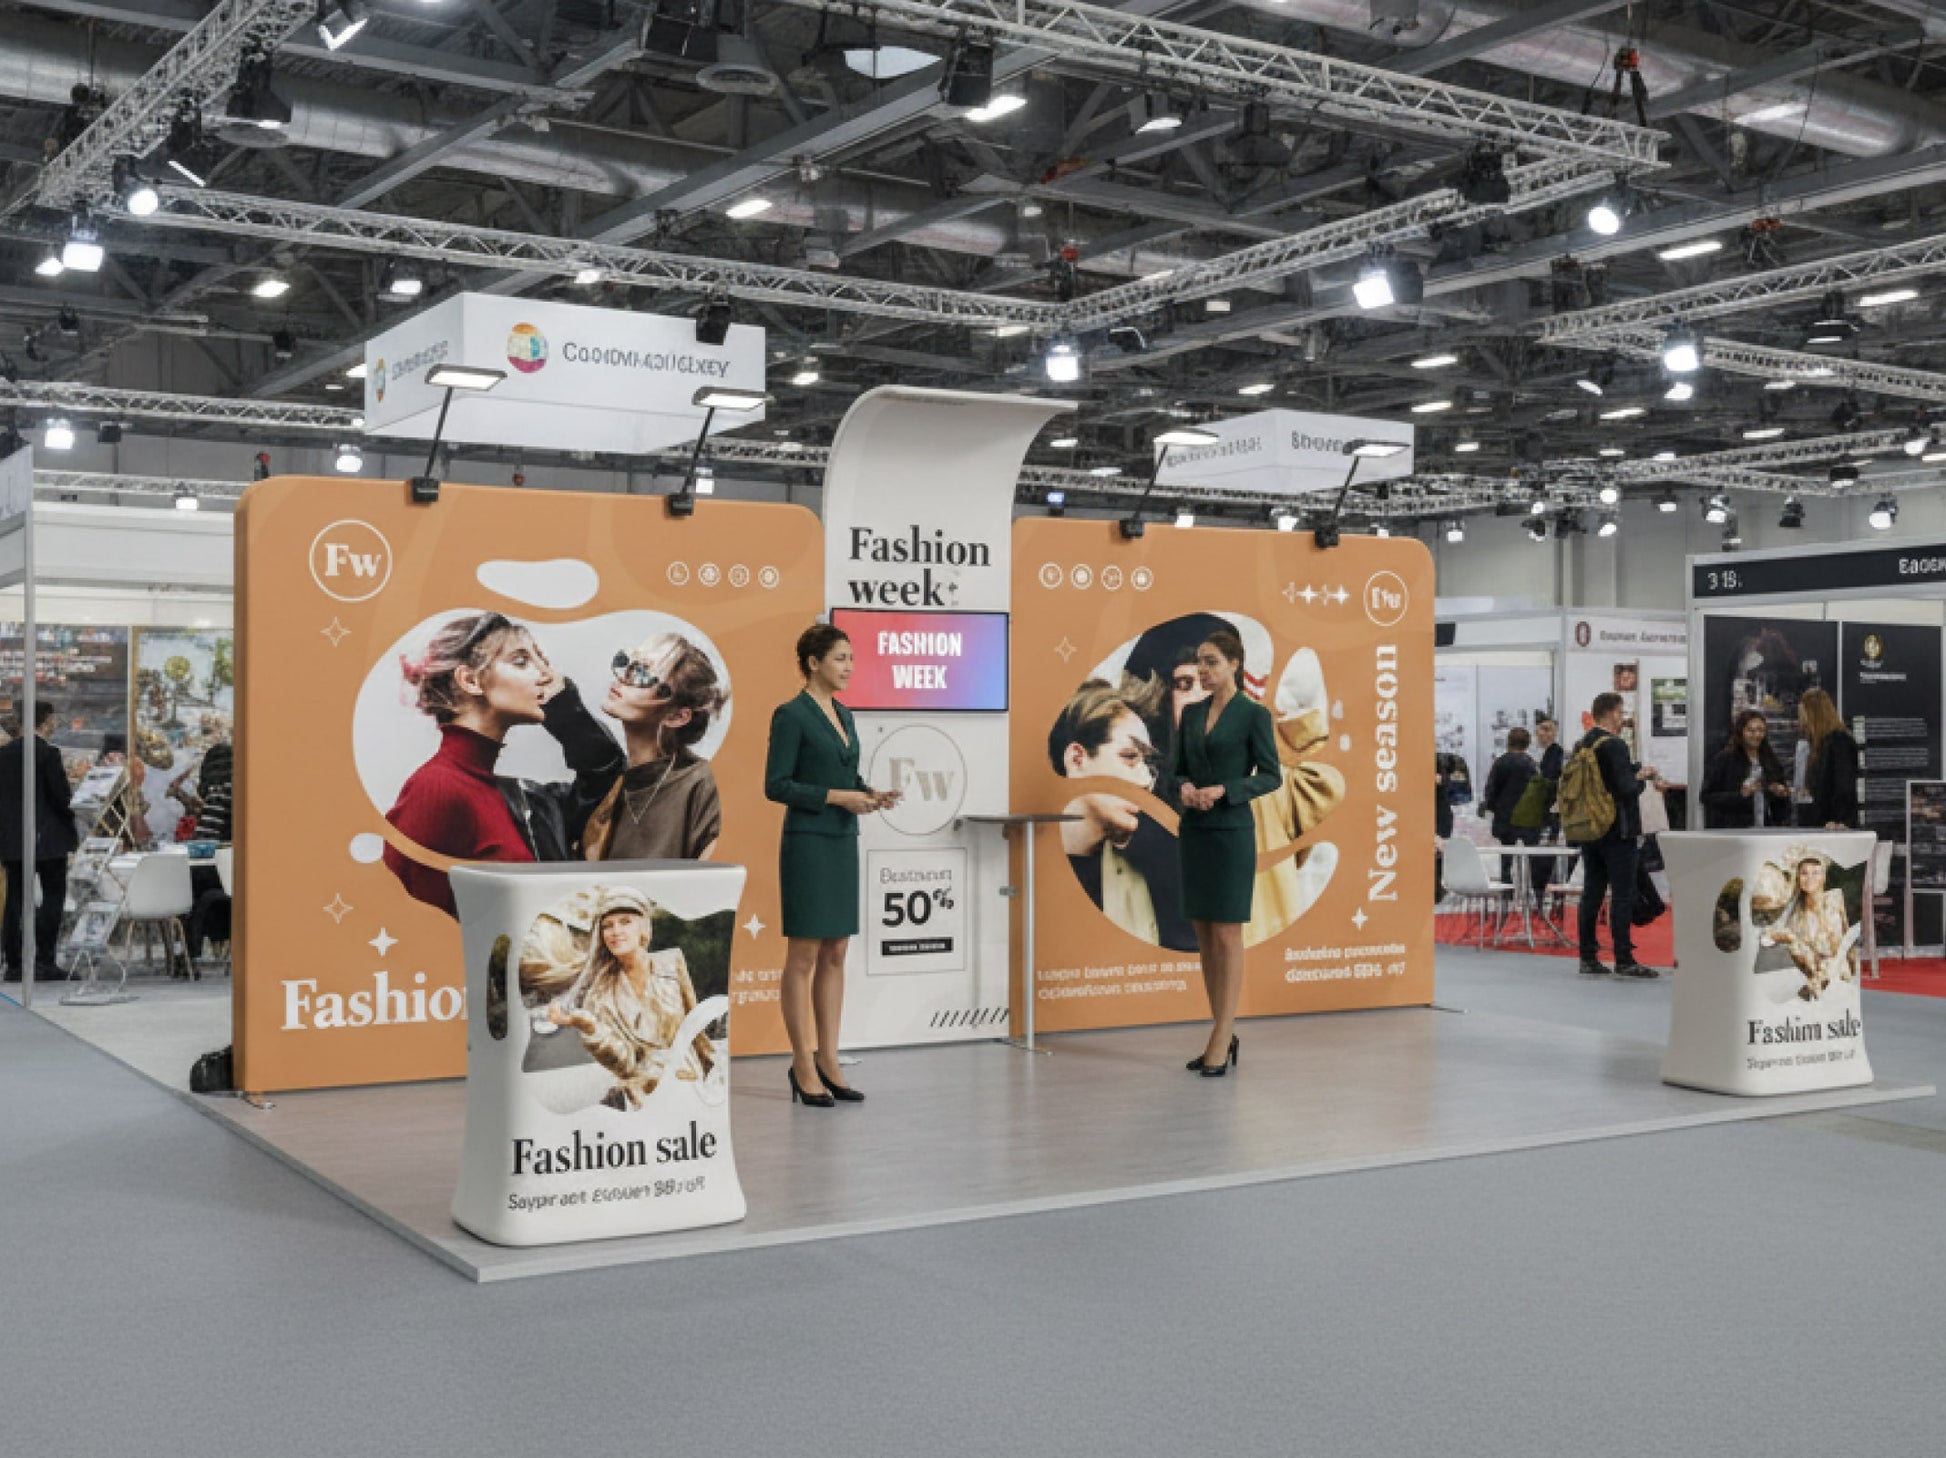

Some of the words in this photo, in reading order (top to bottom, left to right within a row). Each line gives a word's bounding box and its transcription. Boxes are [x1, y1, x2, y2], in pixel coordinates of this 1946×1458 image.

[324, 542, 382, 577] Fw
[849, 524, 991, 566] Fashion
[877, 631, 962, 657] FASHION
[892, 664, 948, 689] WEEK
[1375, 644, 1399, 793] season
[888, 757, 955, 801] Fw
[1368, 804, 1399, 901] New
[280, 970, 468, 1030] Fashio
[512, 1129, 647, 1175] Fashion
[656, 1120, 717, 1164] sale
